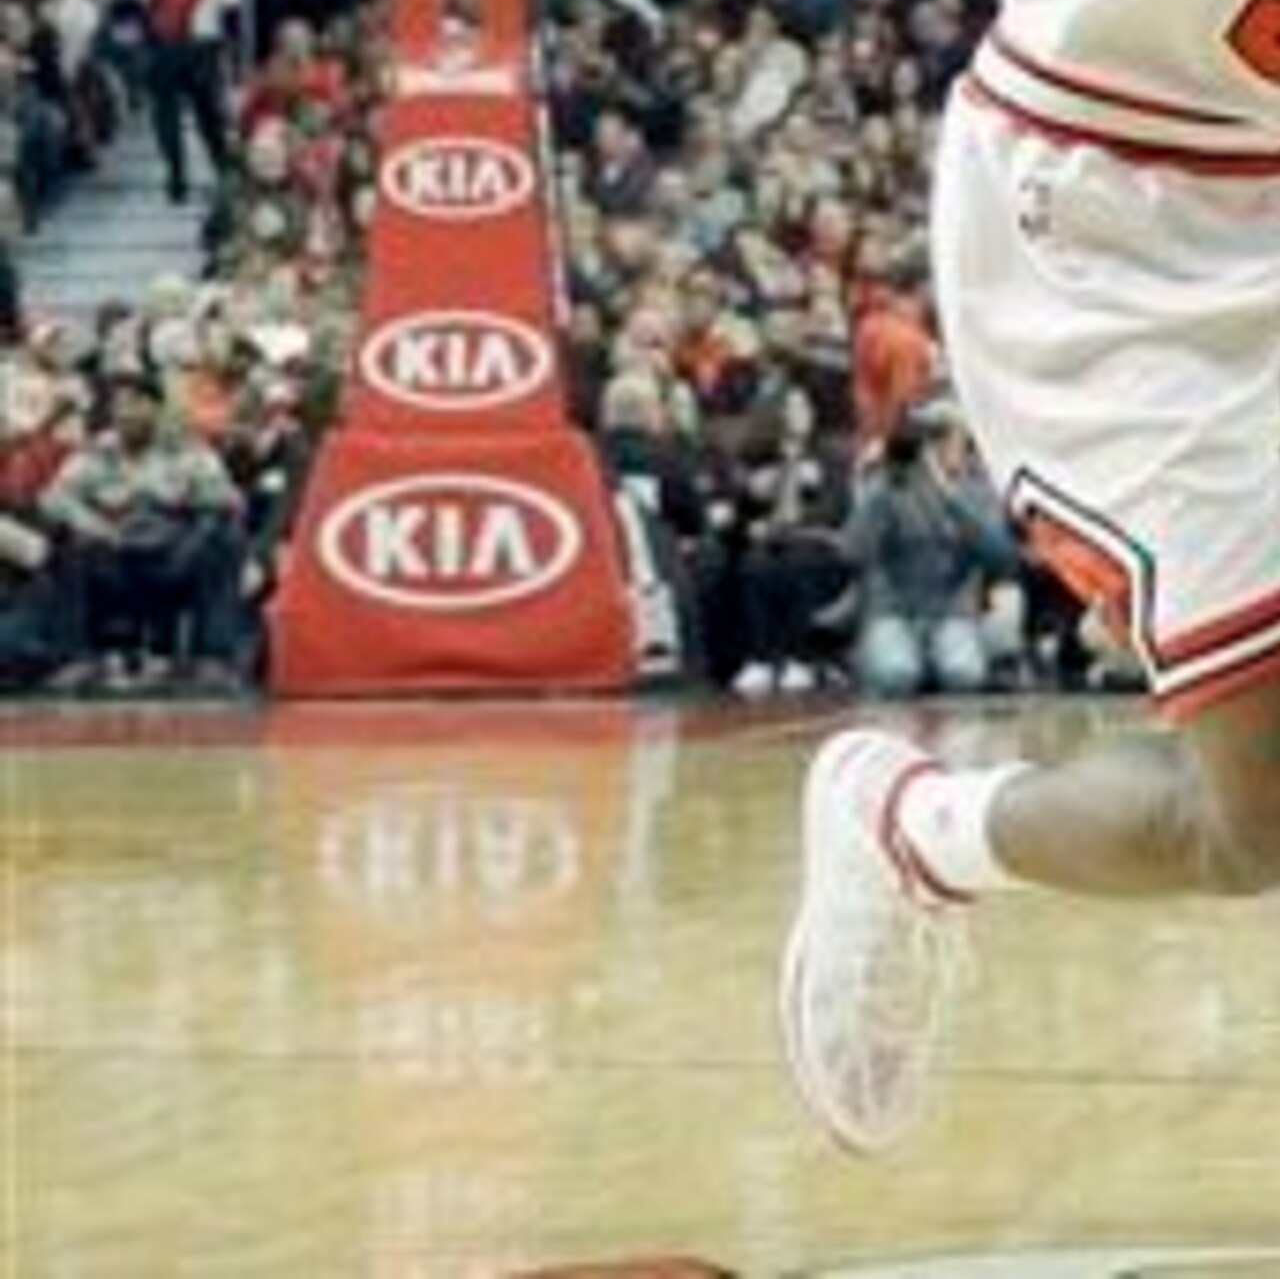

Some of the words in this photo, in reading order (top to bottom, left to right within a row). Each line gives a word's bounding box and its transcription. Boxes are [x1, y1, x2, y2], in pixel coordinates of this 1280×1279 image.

[404, 155, 512, 199] KIA
[395, 333, 519, 387] KIA
[361, 506, 537, 579] KIA
